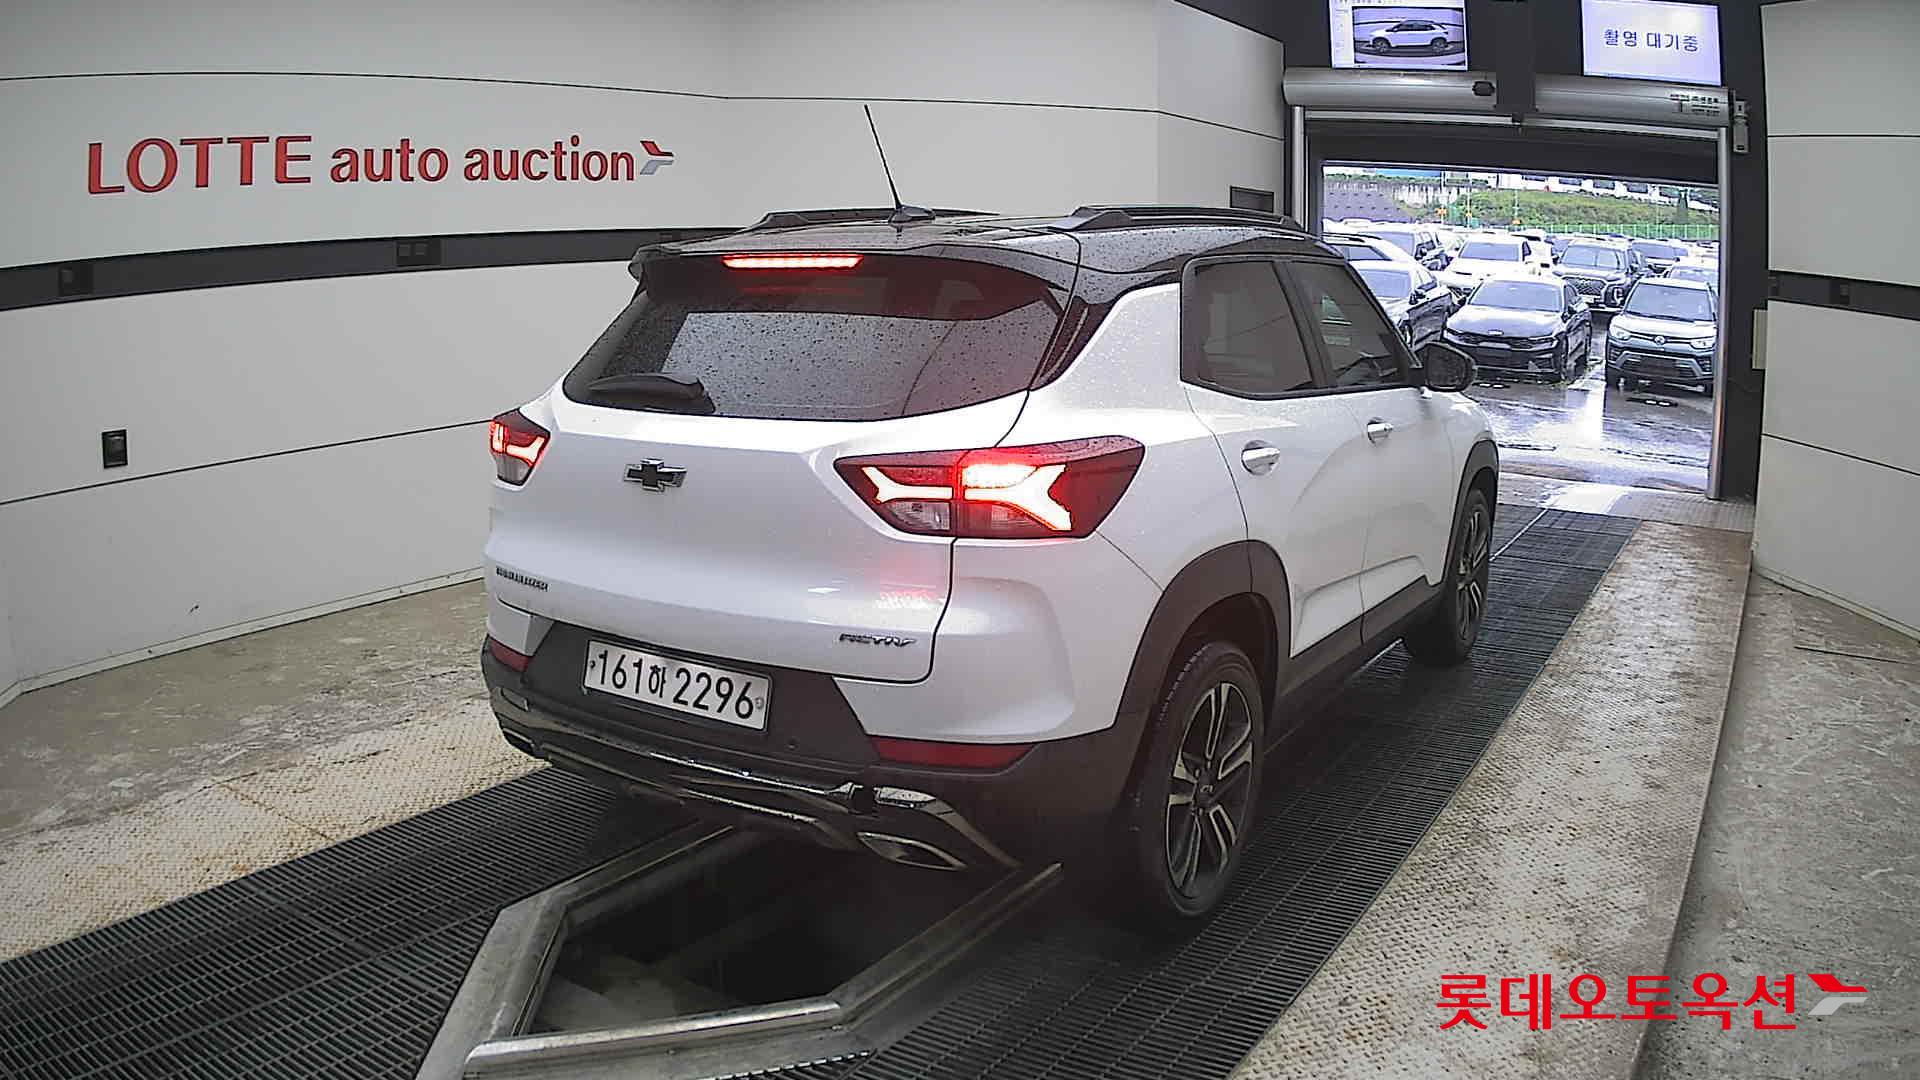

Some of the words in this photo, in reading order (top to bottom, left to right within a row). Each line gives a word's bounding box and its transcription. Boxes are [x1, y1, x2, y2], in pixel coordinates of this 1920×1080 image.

[1646, 32, 1699, 52] 대기중
[88, 135, 312, 194] LOTTE
[330, 138, 448, 182] auto
[463, 135, 634, 182] auction
